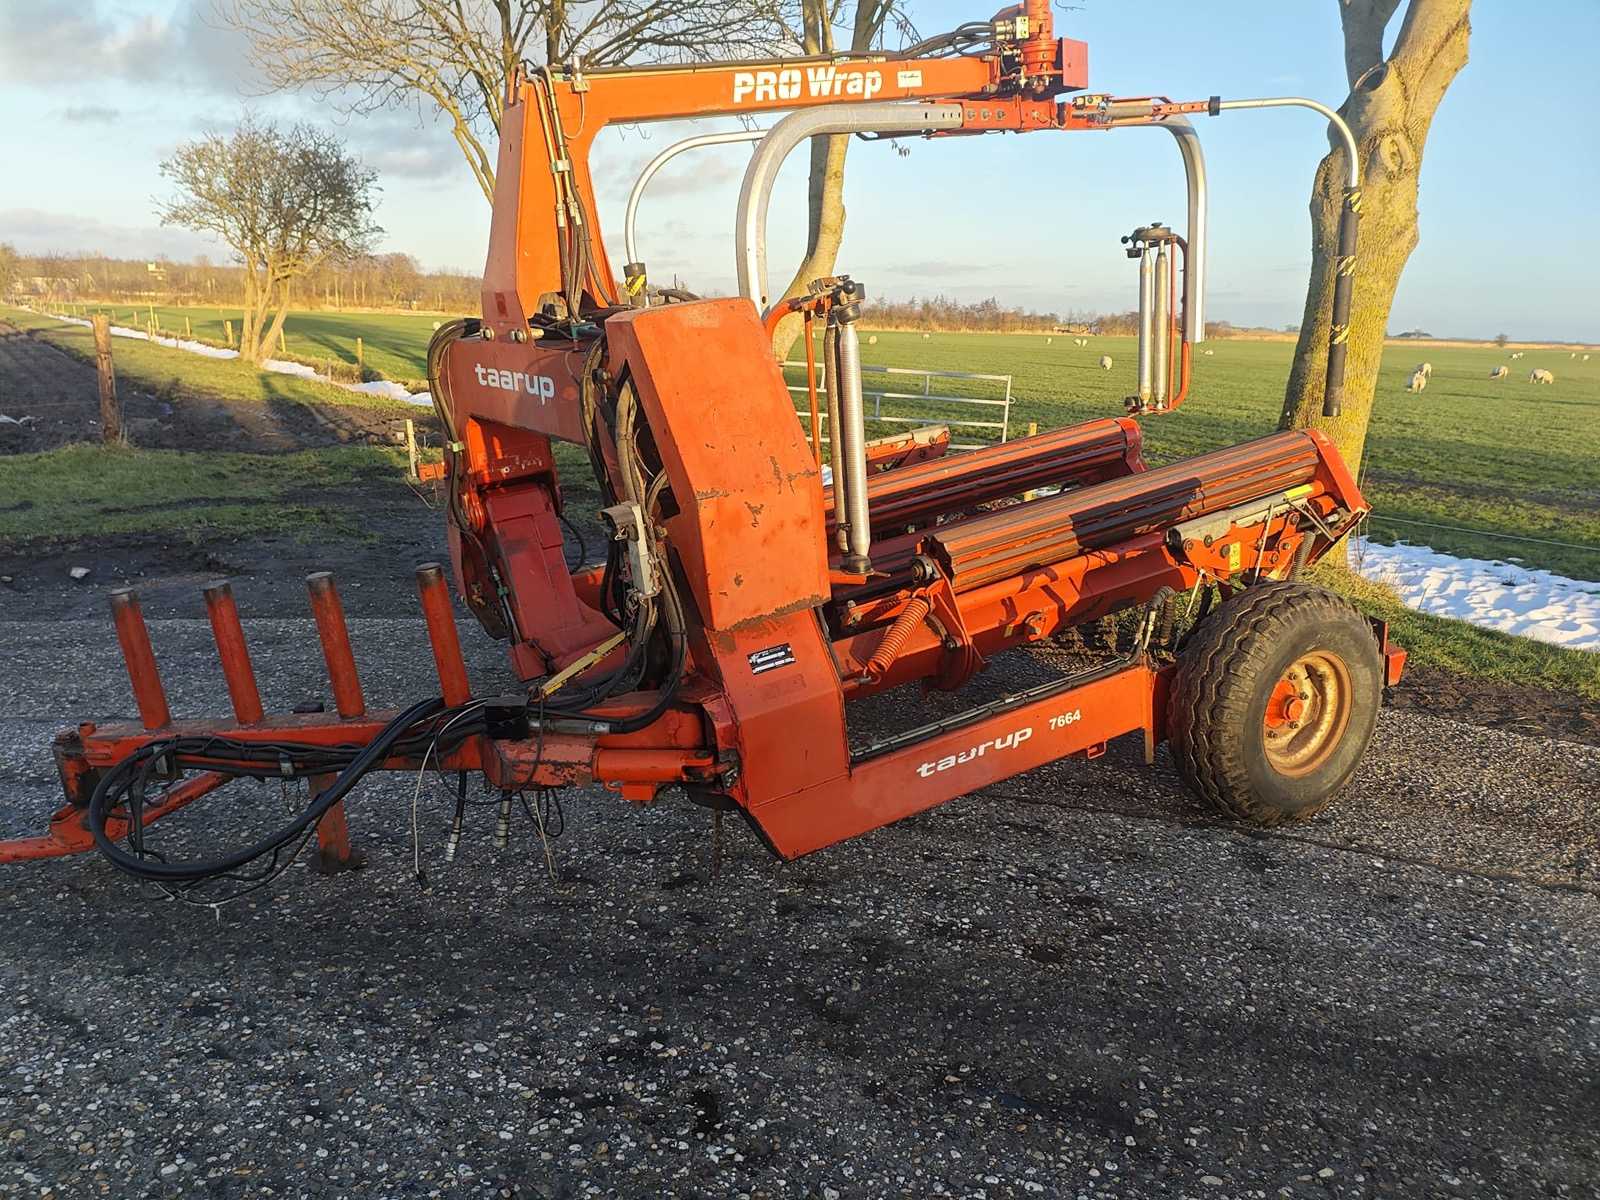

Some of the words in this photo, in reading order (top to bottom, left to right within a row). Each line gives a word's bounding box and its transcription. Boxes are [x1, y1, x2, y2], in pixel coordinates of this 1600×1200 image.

[733, 69, 802, 103] PRO
[806, 66, 883, 99] Wrap
[475, 363, 555, 405] taarup
[916, 727, 1033, 778] taarup
[1049, 709, 1081, 730] 7664
